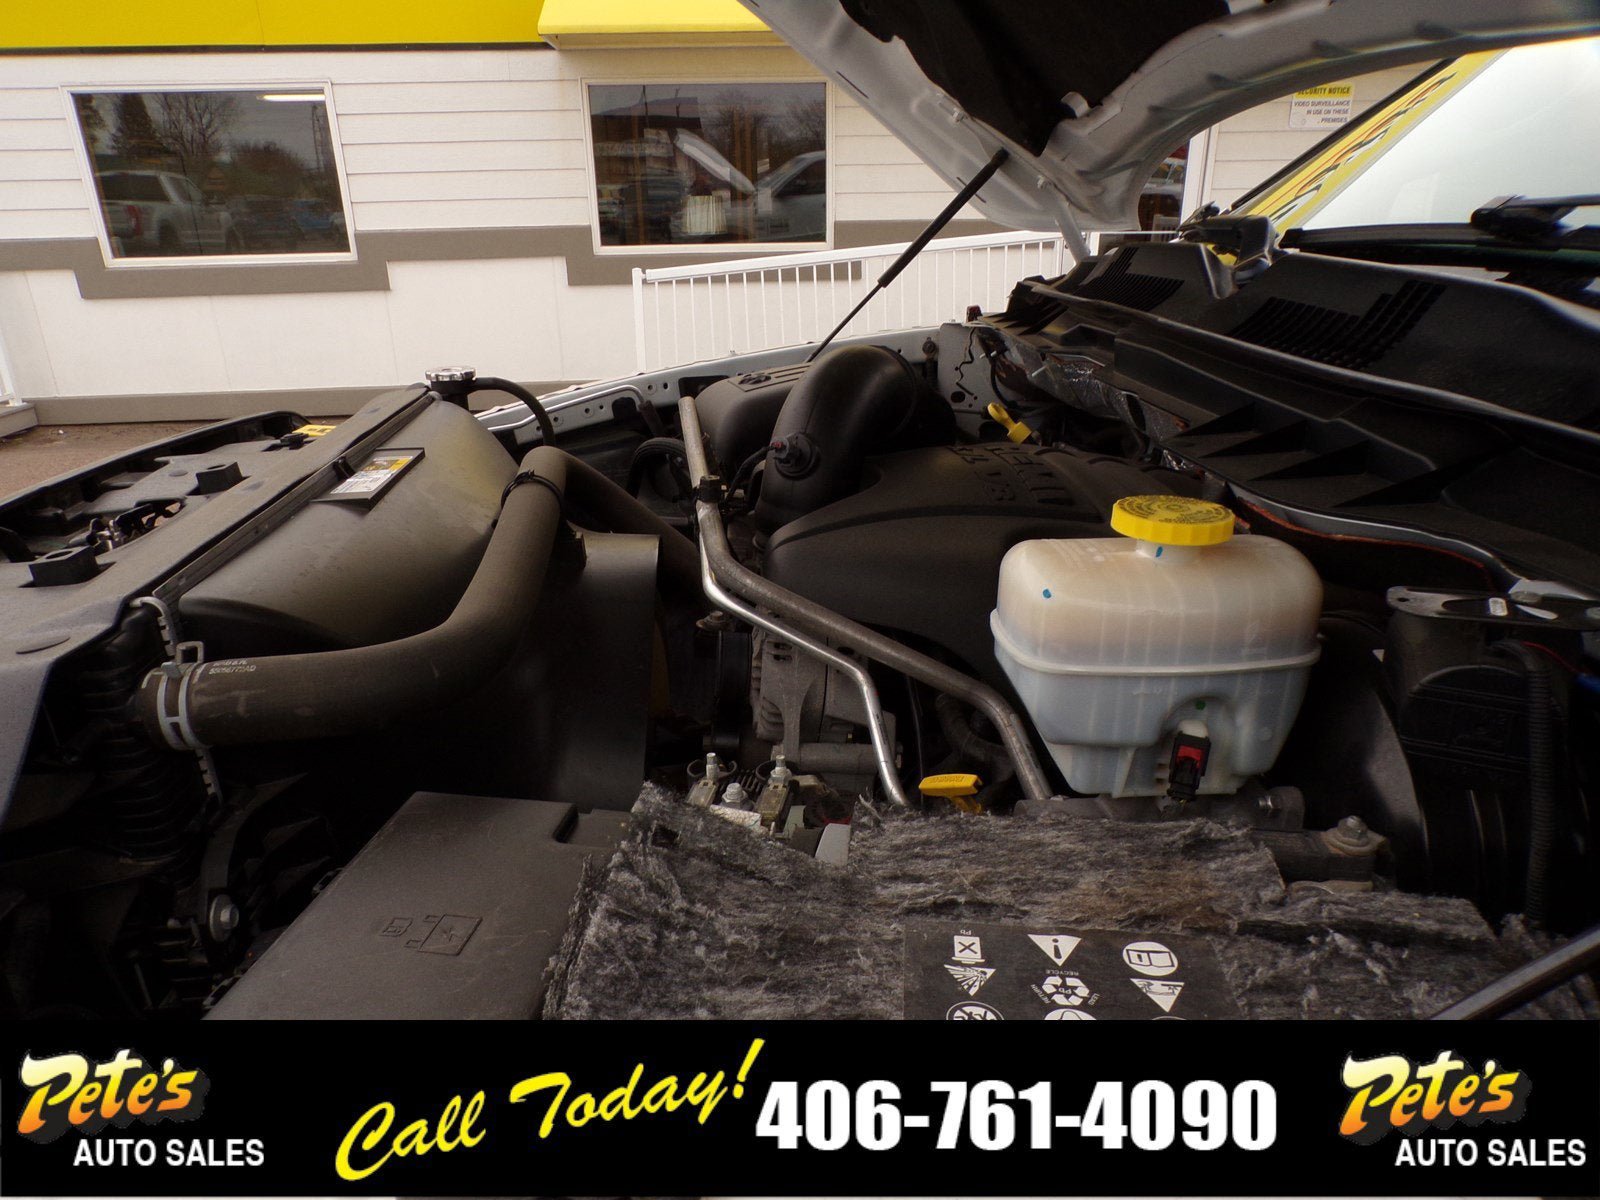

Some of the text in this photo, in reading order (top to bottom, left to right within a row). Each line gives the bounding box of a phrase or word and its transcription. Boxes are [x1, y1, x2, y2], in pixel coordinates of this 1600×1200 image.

[1328, 86, 1351, 95] NOTICE
[1311, 99, 1351, 107] SURVEILLANCE
[1030, 983, 1051, 1005] RETURN
[1058, 987, 1072, 995] Pb
